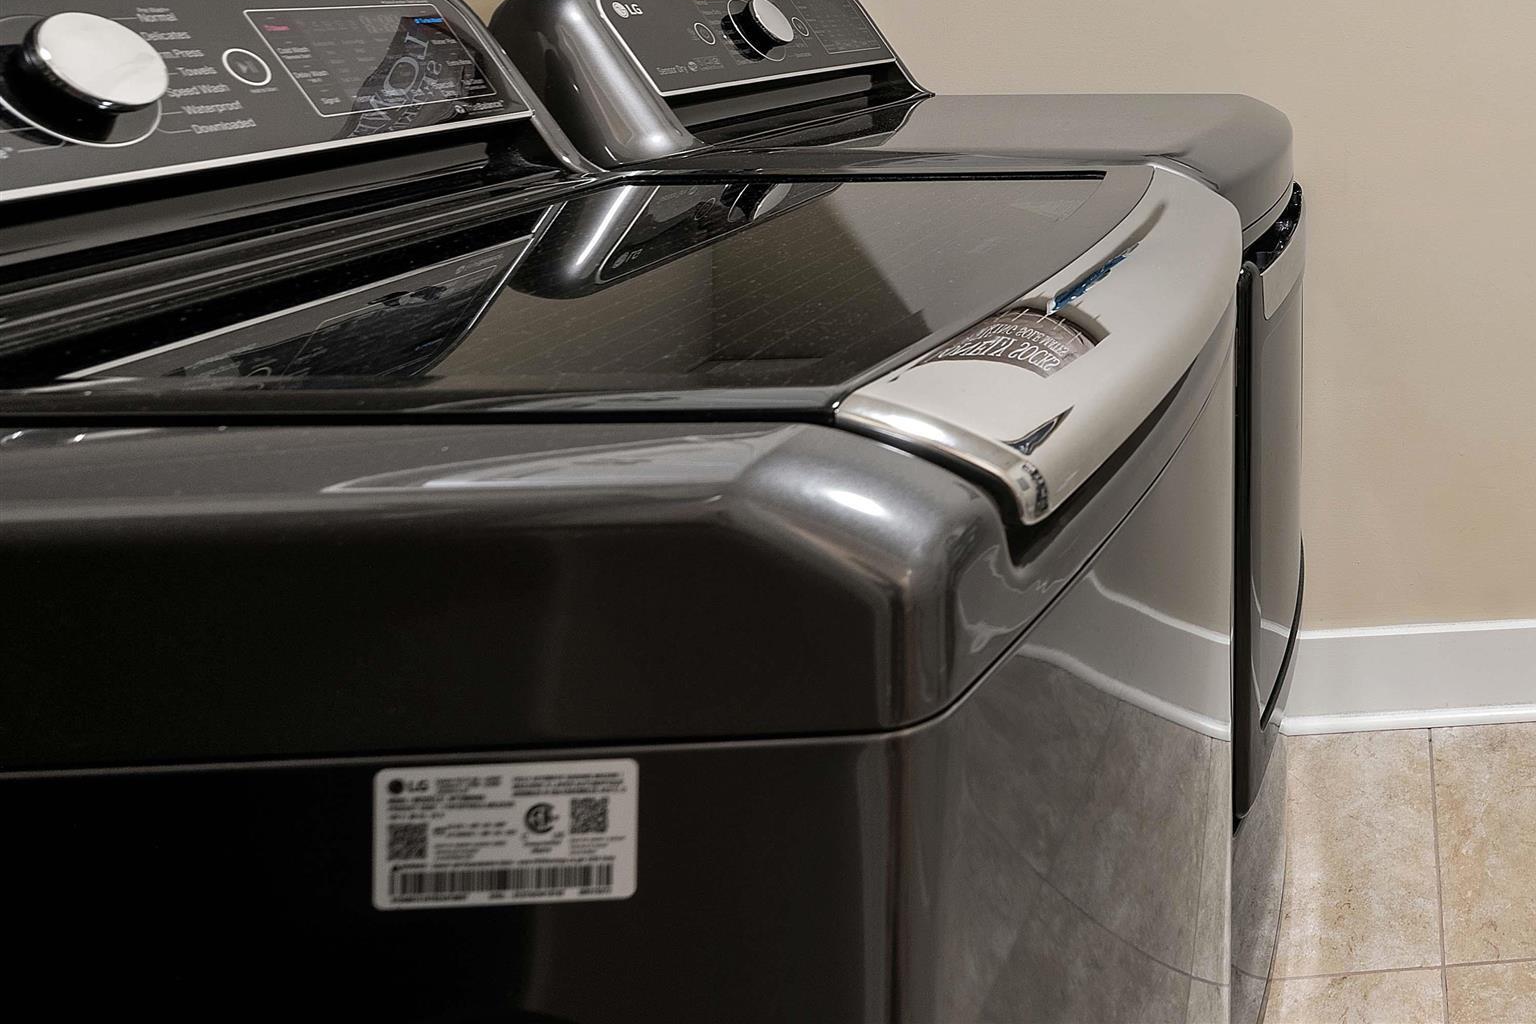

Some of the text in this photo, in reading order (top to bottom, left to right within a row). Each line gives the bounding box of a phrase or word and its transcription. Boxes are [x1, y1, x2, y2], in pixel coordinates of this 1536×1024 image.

[626, 3, 643, 16] LG
[136, 13, 178, 23] Normal
[139, 31, 191, 41] Delicates
[178, 66, 218, 76] Towels
[167, 84, 231, 98] Speed Wash
[182, 100, 244, 115] Waterproof
[192, 118, 257, 134] Downloaded
